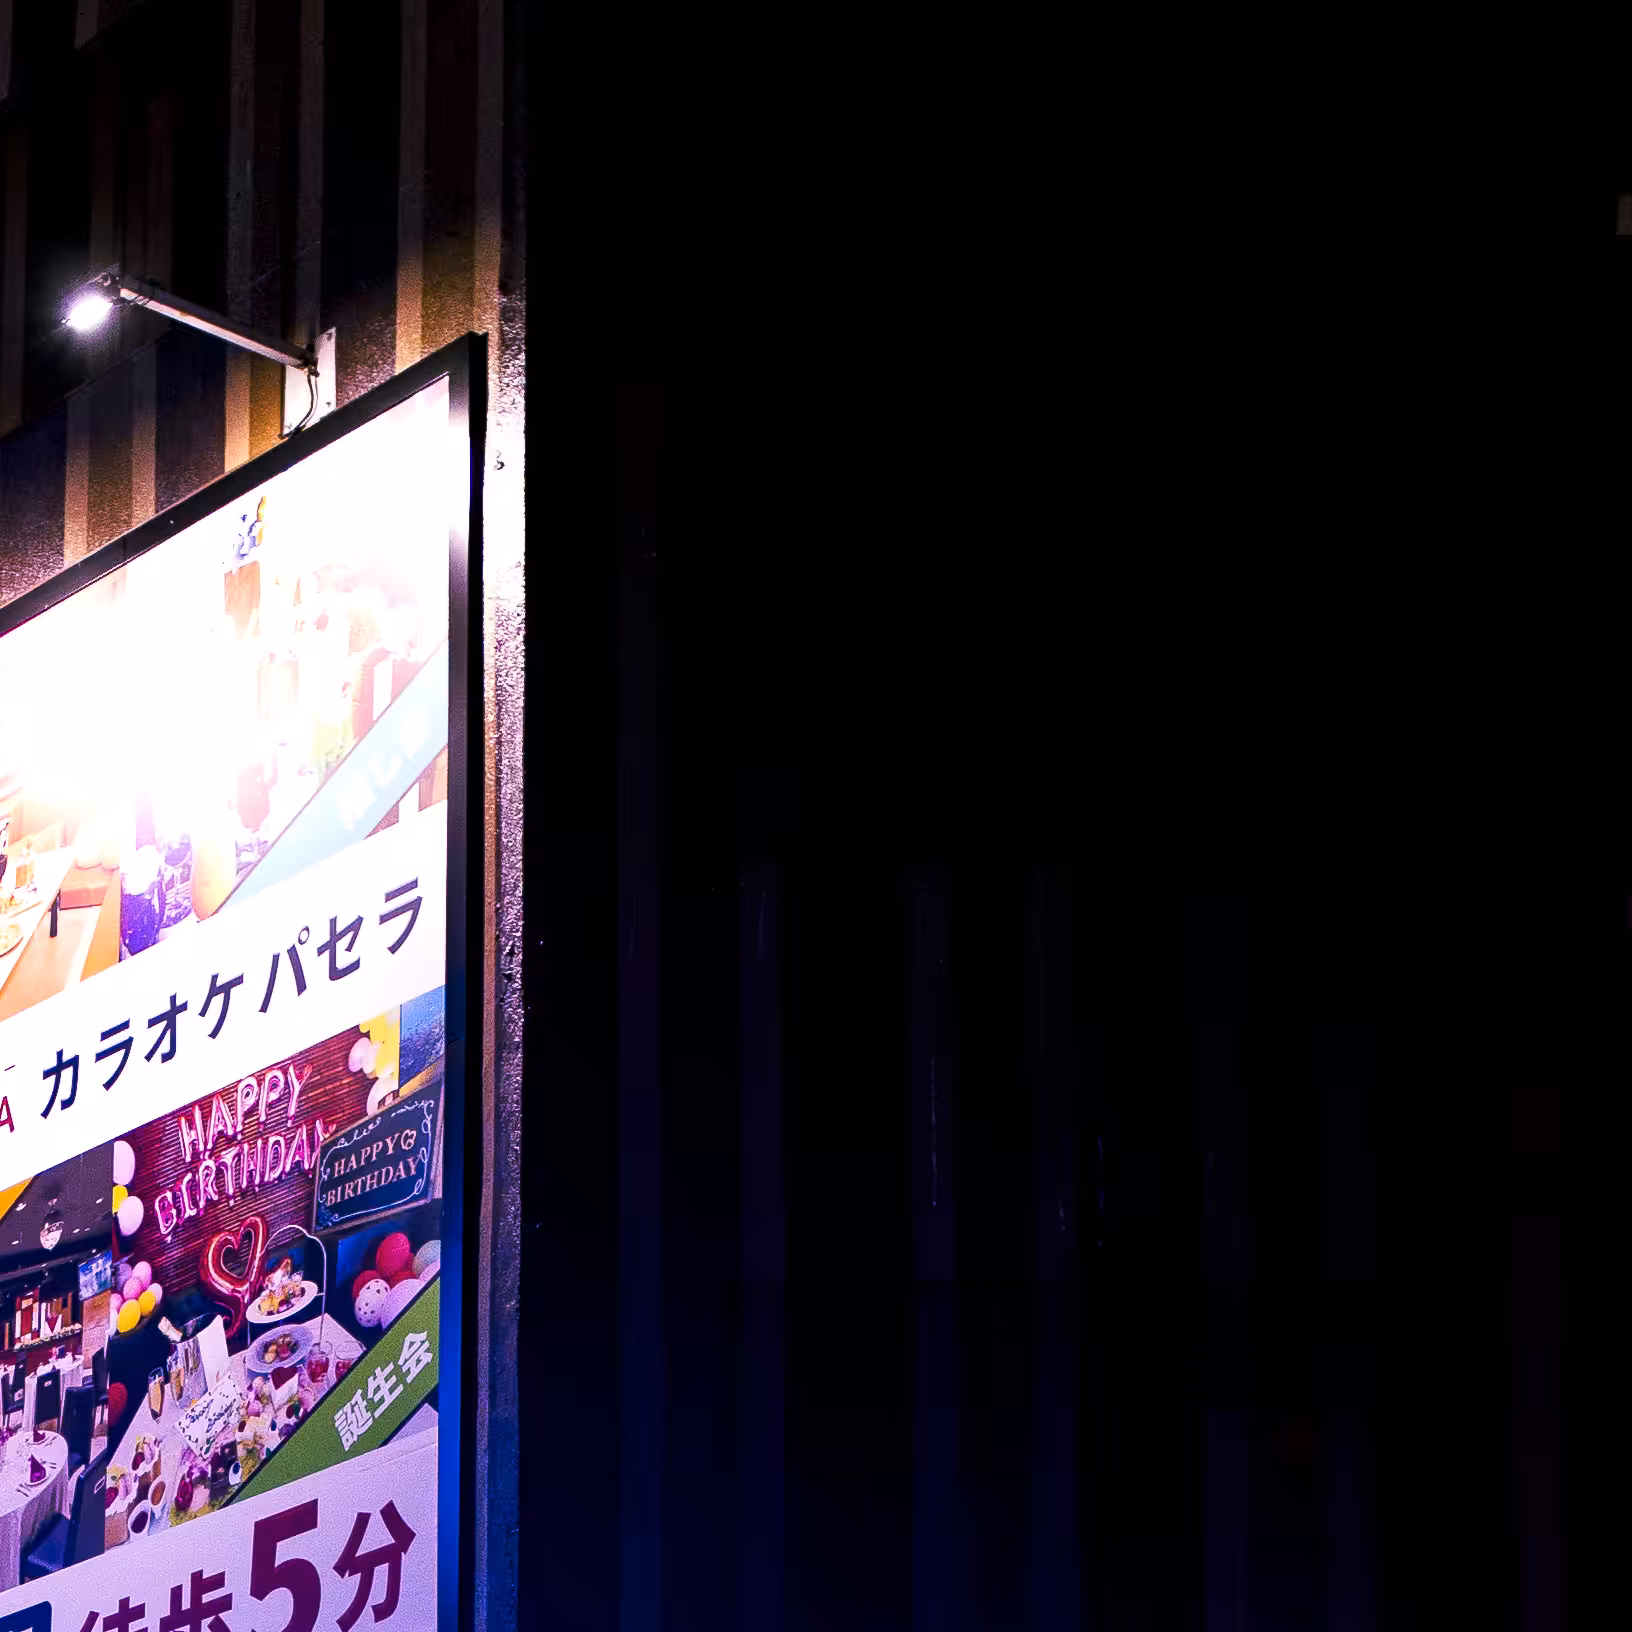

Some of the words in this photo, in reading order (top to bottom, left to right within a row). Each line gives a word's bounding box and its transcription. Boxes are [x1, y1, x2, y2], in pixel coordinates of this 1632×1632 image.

[40, 877, 424, 1120] カラオケパセラ
[177, 1062, 313, 1163] HAPPY
[332, 1134, 401, 1179] HAPPY
[325, 1157, 420, 1207] BIRTHDAY
[333, 1328, 434, 1452] 誕生会
